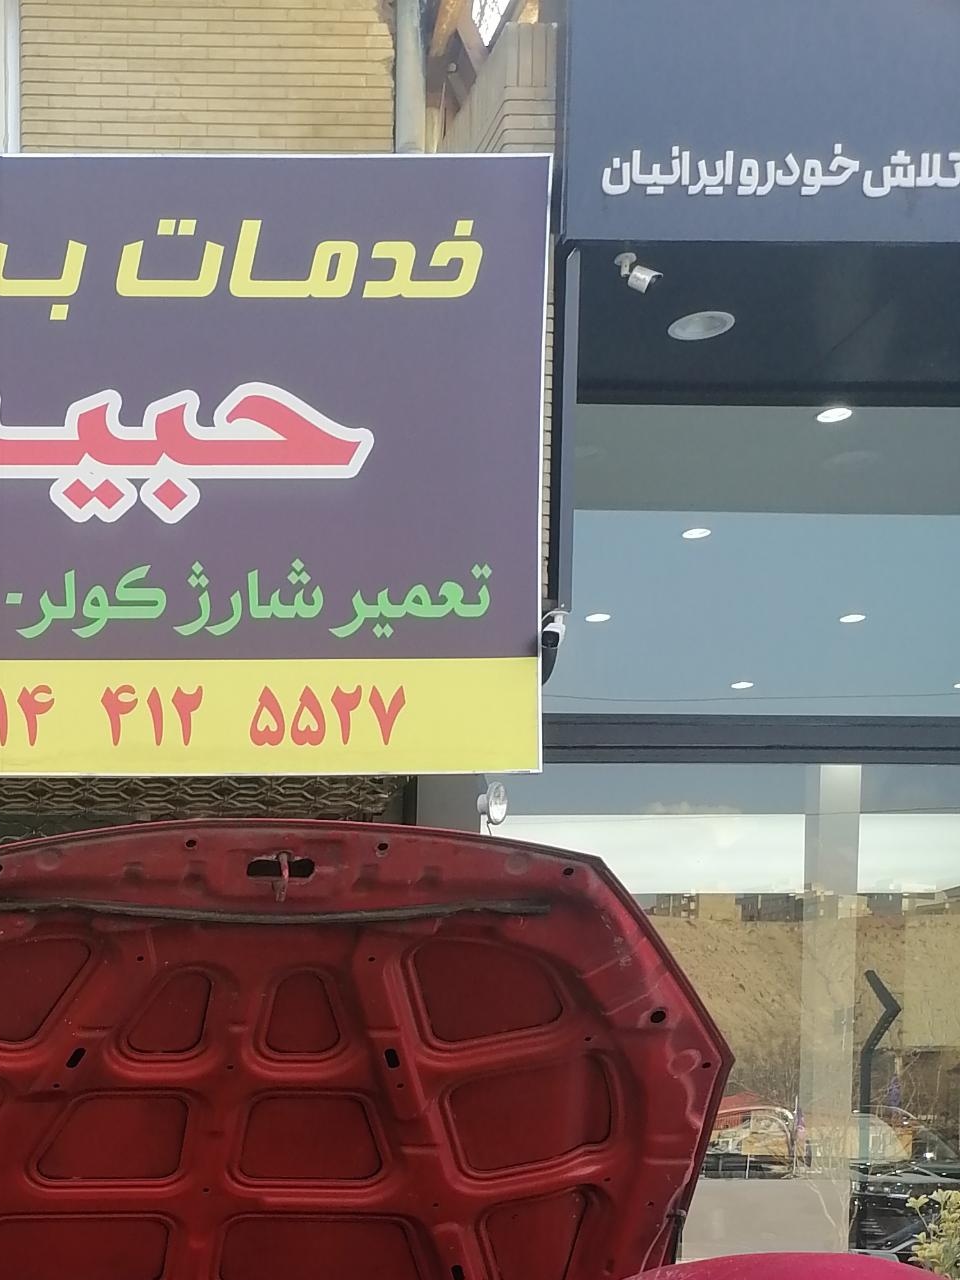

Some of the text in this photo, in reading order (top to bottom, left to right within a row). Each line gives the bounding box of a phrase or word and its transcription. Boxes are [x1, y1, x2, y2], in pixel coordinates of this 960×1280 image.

[602, 145, 734, 196] ایرانیان
[738, 143, 860, 197] خودرو
[115, 219, 484, 300] خدمات
[174, 558, 324, 638] شارژ
[330, 563, 493, 639] تعمیر
[101, 684, 205, 747] ۴۱۲
[249, 686, 406, 747] ۵۵۲۷
